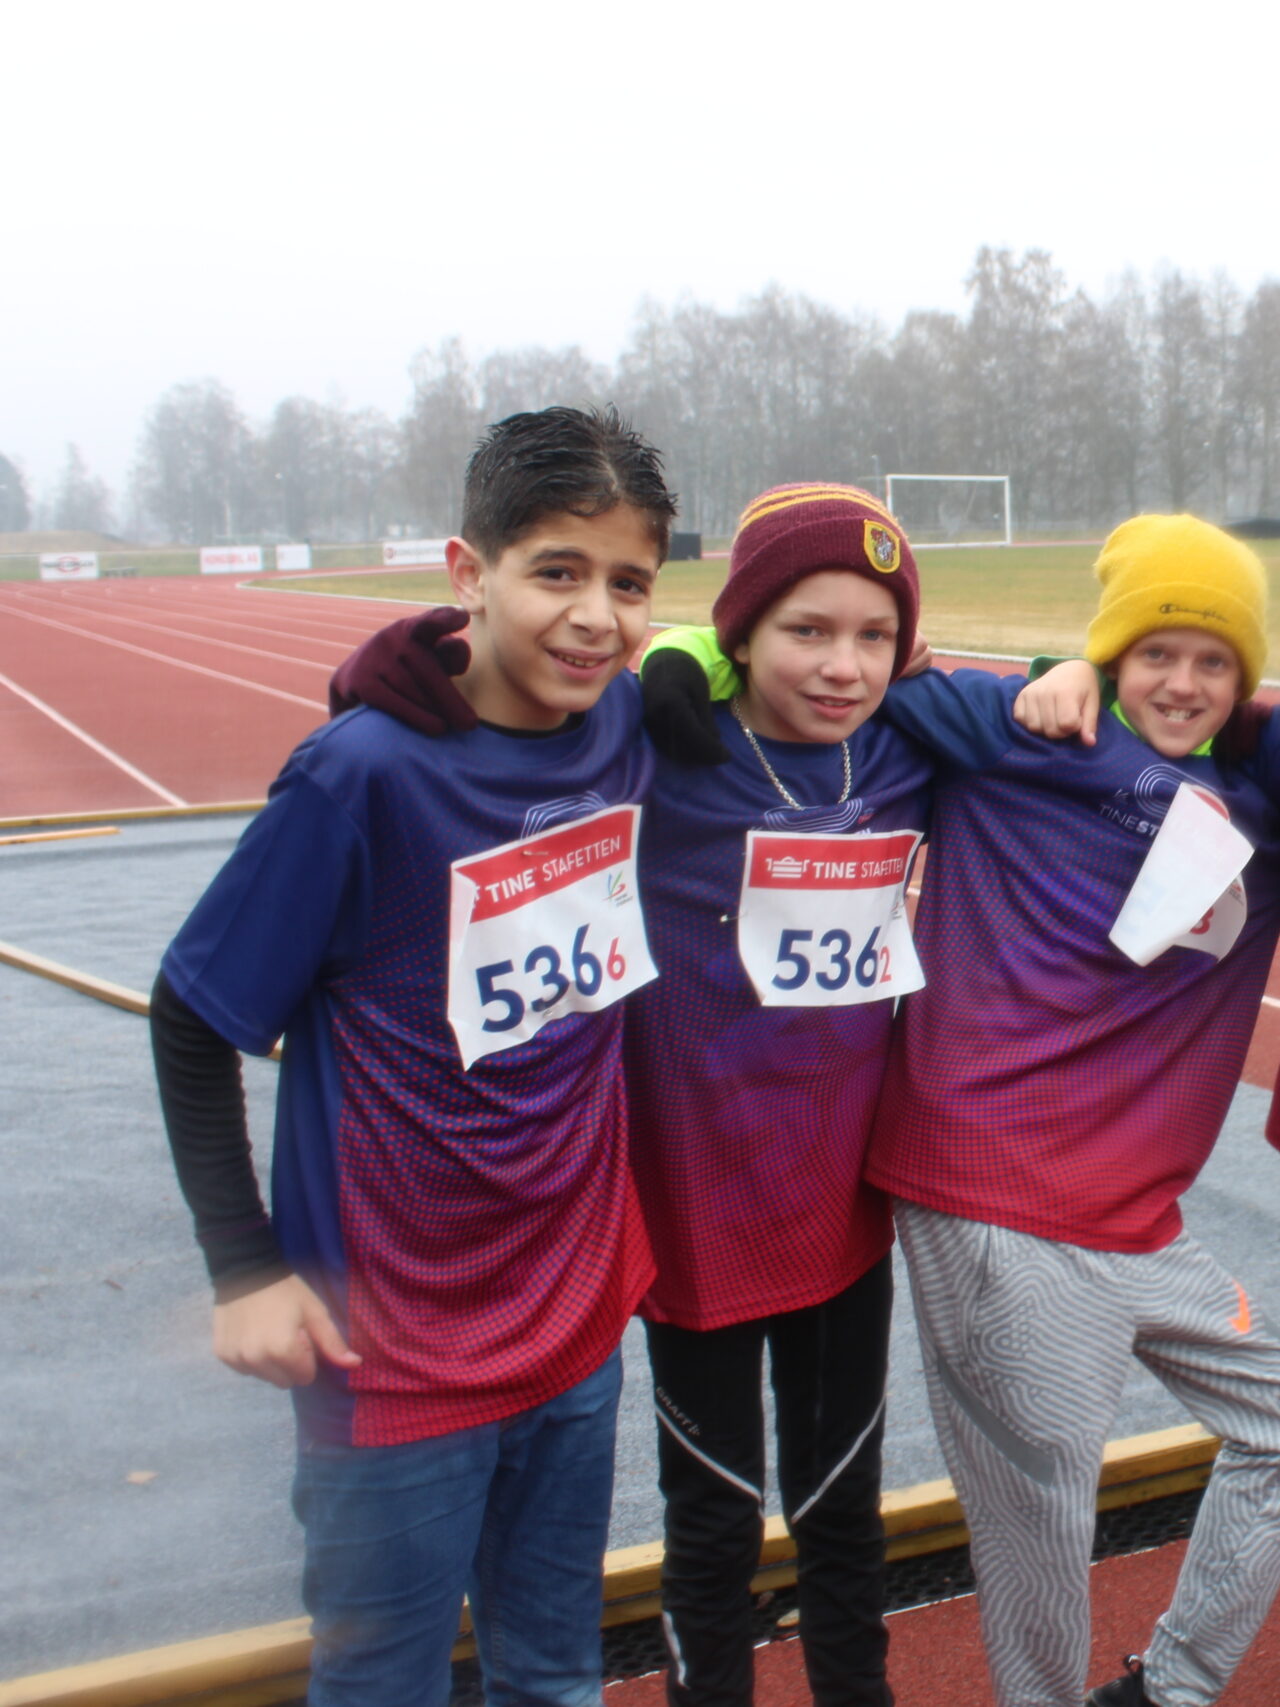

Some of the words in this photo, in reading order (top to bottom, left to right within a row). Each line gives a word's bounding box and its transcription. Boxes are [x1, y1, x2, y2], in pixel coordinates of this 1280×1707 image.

[484, 868, 535, 904] TINE
[542, 835, 621, 882] STAFETTEN
[812, 861, 856, 879] TINE
